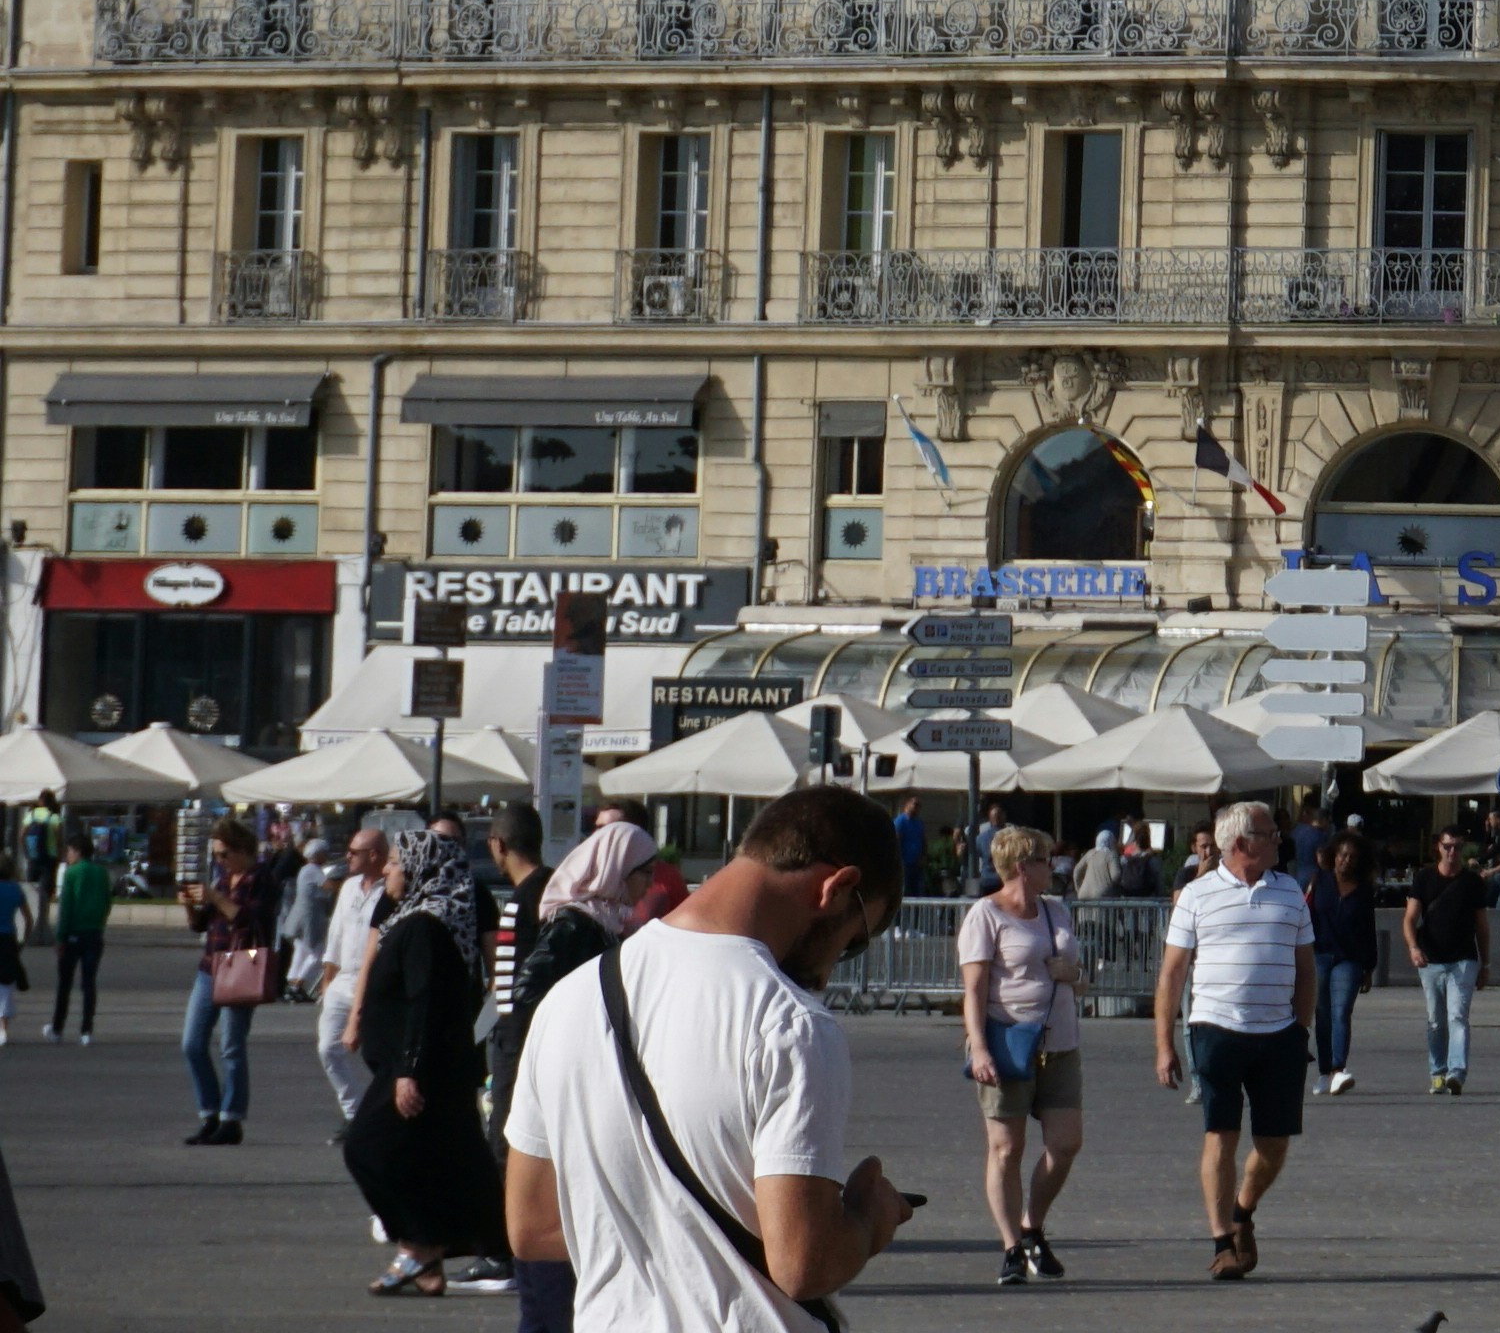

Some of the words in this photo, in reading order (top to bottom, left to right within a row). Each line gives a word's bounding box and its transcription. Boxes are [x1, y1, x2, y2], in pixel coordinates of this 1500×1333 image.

[279, 412, 296, 423] Sud
[595, 412, 614, 424] Une
[644, 412, 658, 423] Au
[659, 411, 678, 423] Sud
[405, 571, 707, 606] RESTAURANT
[915, 565, 1146, 598] BRASSERIE
[620, 611, 679, 633] Sud
[977, 621, 995, 630] Port
[654, 686, 793, 705] RESTAURANT
